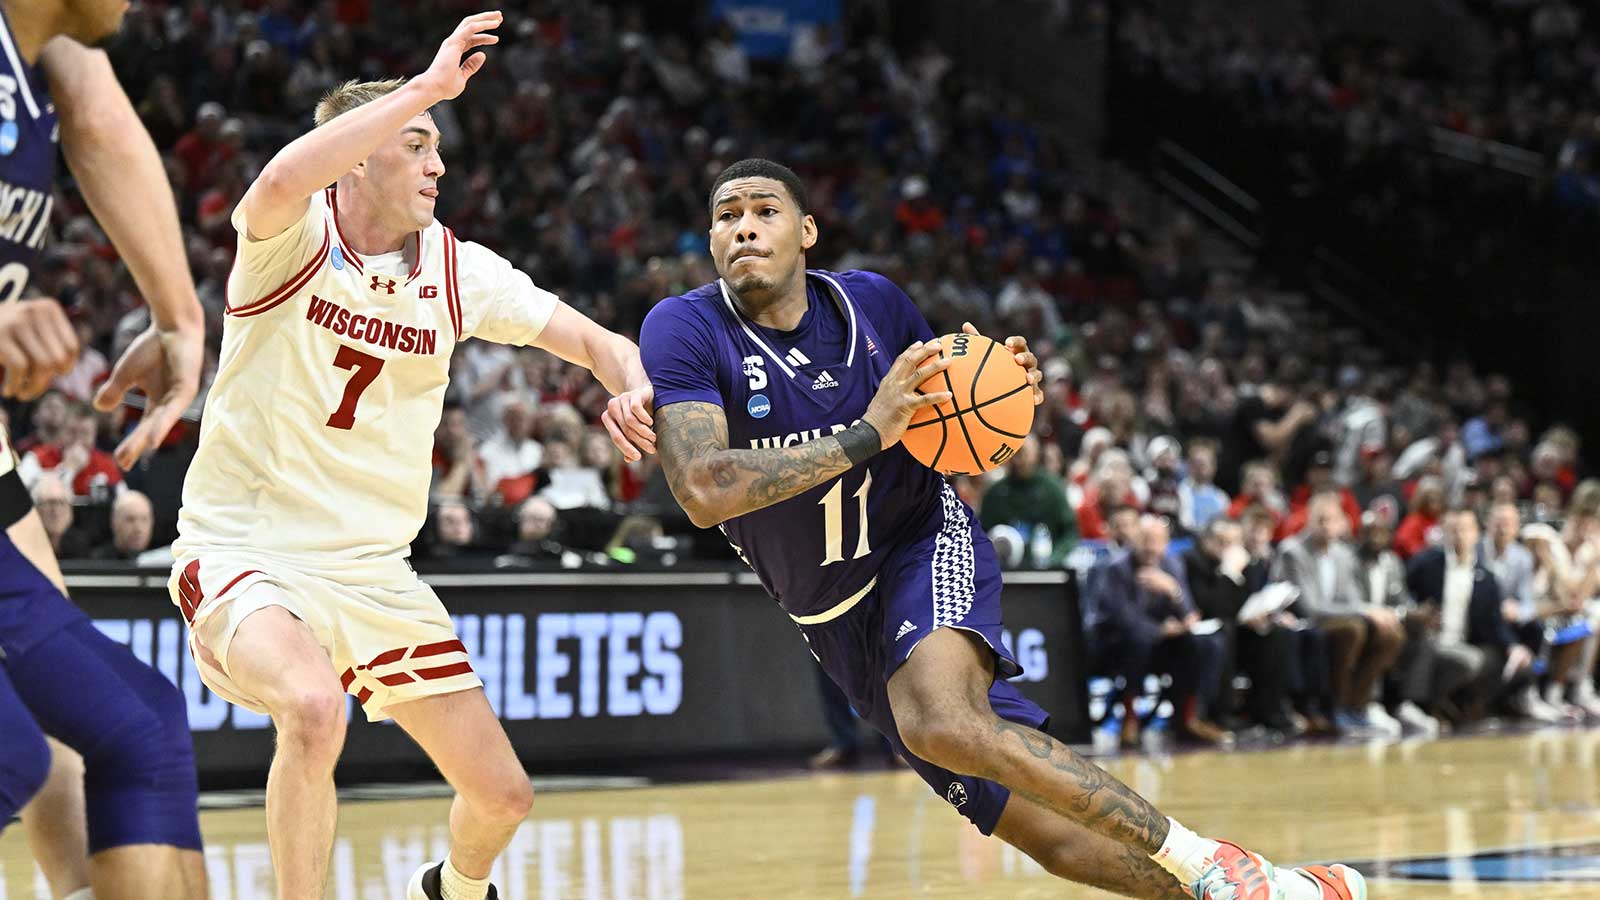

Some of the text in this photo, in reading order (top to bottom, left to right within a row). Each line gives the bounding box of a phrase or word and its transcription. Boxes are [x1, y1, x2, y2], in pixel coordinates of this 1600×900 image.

[306, 294, 437, 355] WISCONSIN
[325, 344, 385, 430] 7
[750, 403, 771, 415] NCAA
[811, 380, 839, 391] adidas
[817, 467, 872, 567] 11
[450, 611, 683, 720] HLETES
